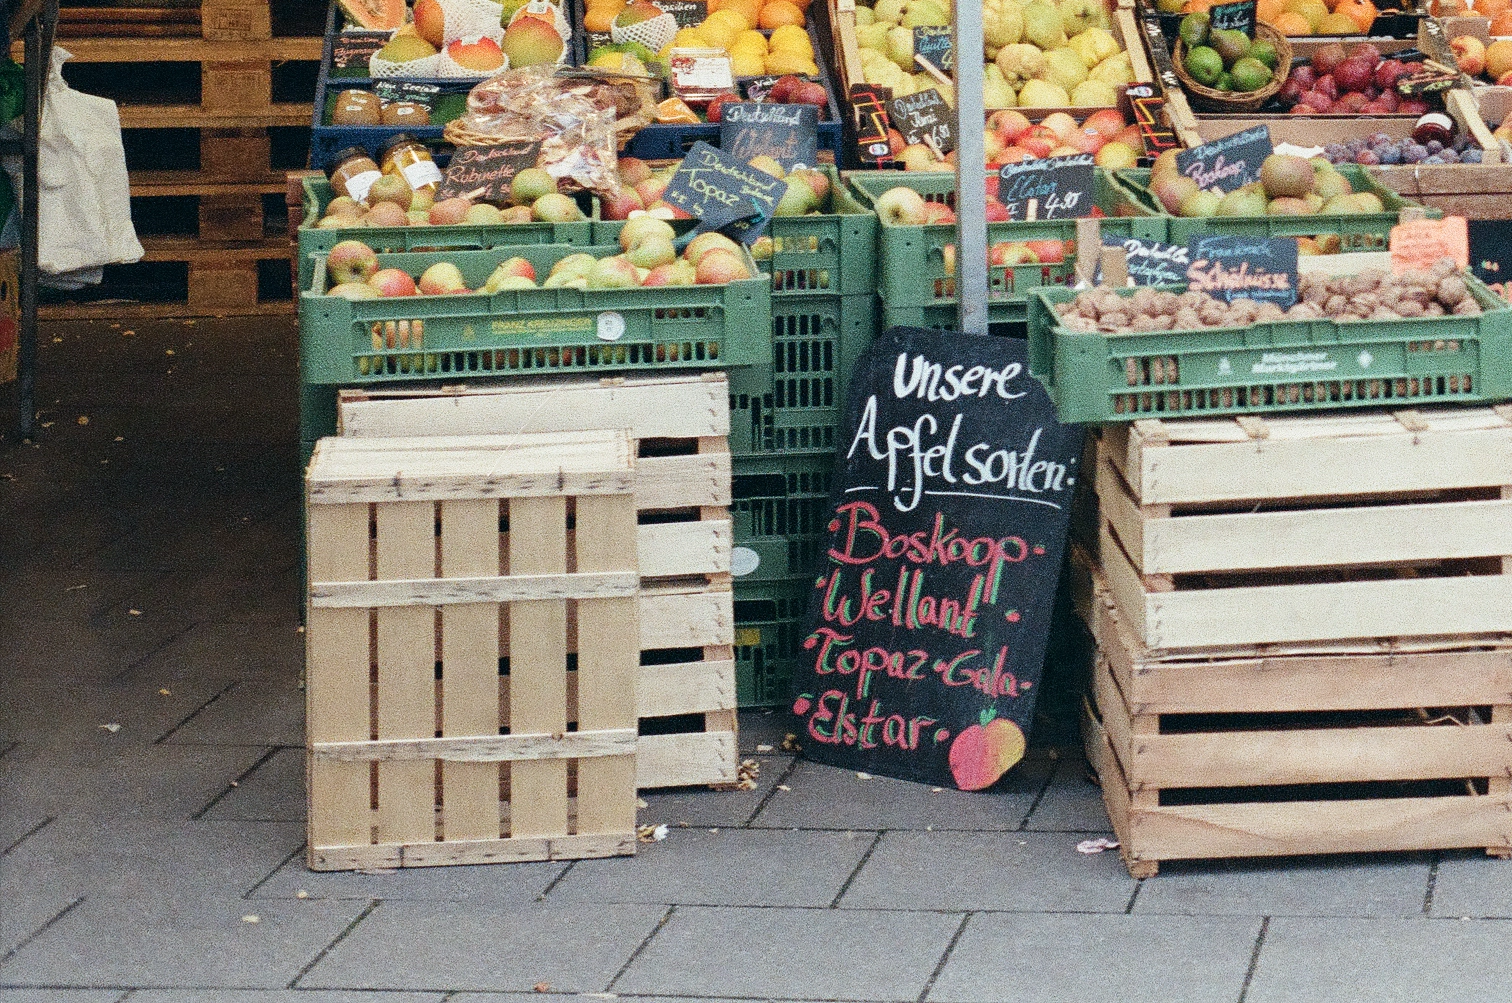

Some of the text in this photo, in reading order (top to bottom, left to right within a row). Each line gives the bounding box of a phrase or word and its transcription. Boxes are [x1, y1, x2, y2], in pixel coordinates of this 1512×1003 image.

[679, 167, 740, 207] Topaz
[893, 351, 1027, 403] Unsere
[827, 500, 1028, 606] Boskoop
[821, 565, 985, 639] Wellant
[814, 625, 1020, 700] Topaz Gala
[808, 689, 940, 751] Elstar
